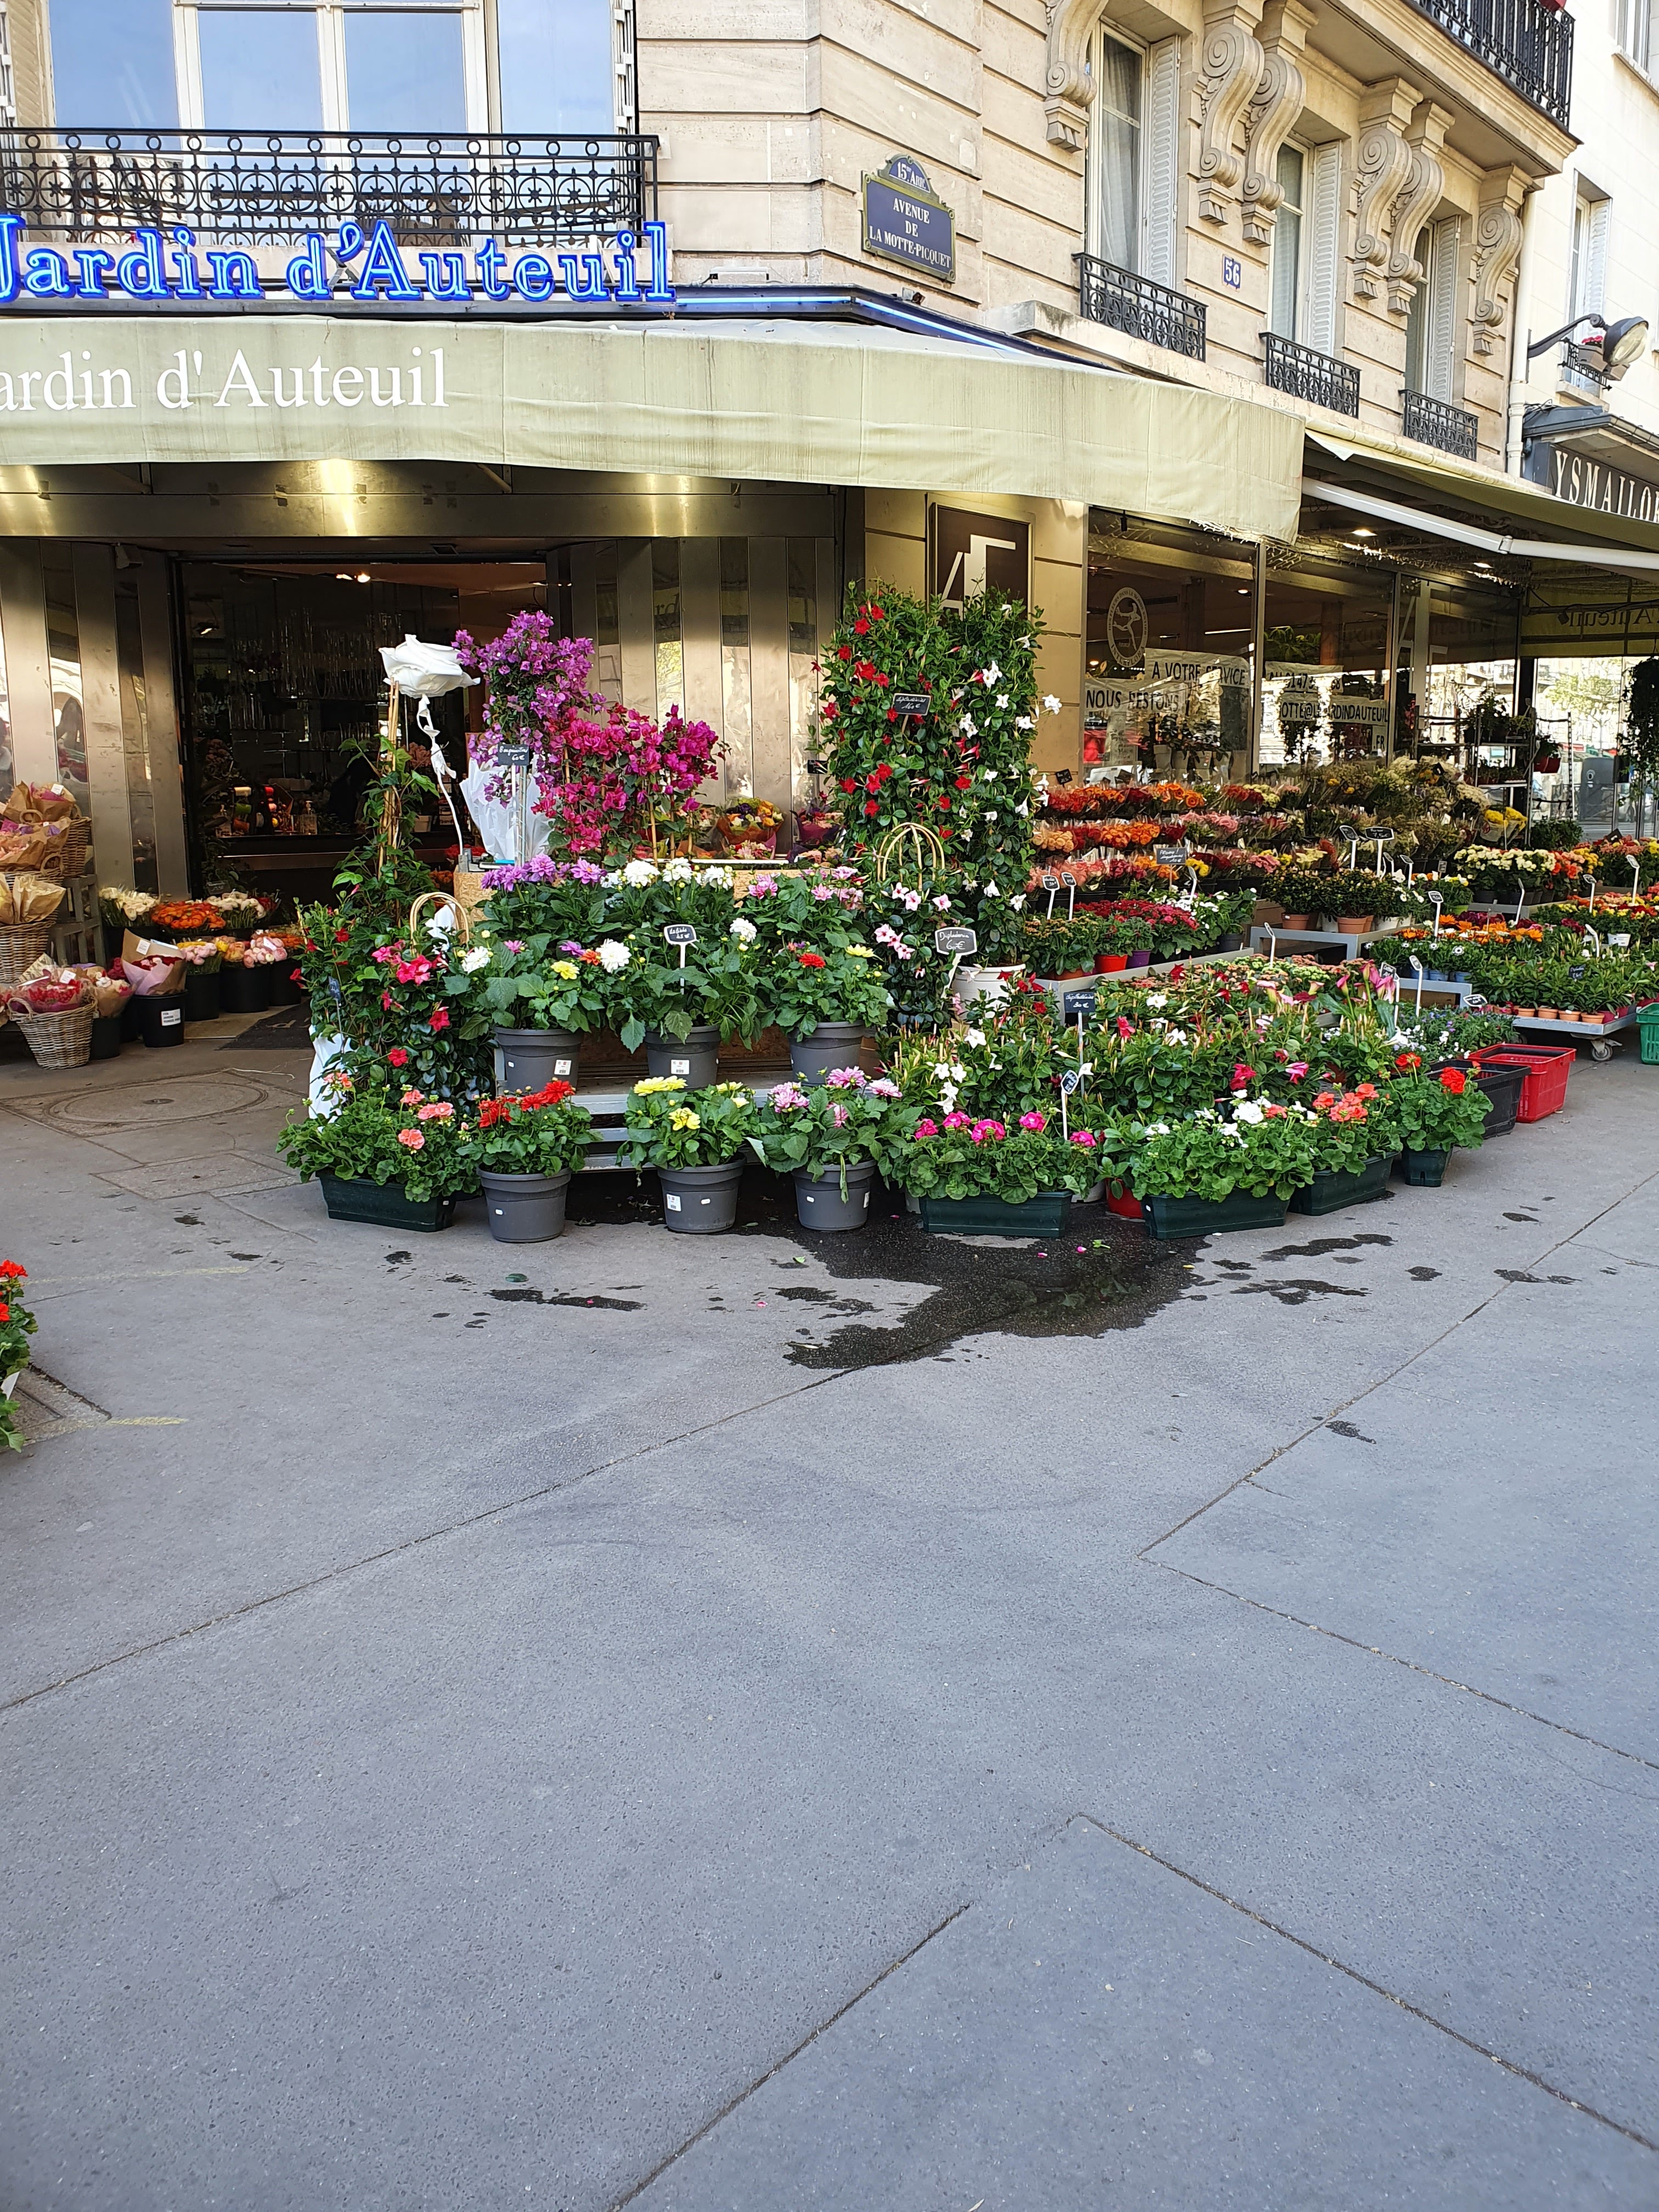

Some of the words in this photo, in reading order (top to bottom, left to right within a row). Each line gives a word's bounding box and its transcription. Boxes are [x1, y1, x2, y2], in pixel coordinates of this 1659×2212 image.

[893, 198, 930, 224] AVENUE
[905, 220, 918, 238] DE
[870, 225, 882, 242] LA
[884, 230, 951, 268] MOTTE-PICQUET
[0, 215, 267, 303] Jardin
[1225, 259, 1240, 285] 56
[1152, 662, 1161, 679] A
[1165, 662, 1201, 681] VOTRE
[1086, 690, 1122, 708] NOUS
[1373, 735, 1385, 749] .FR
[939, 930, 969, 941] Dipladenia
